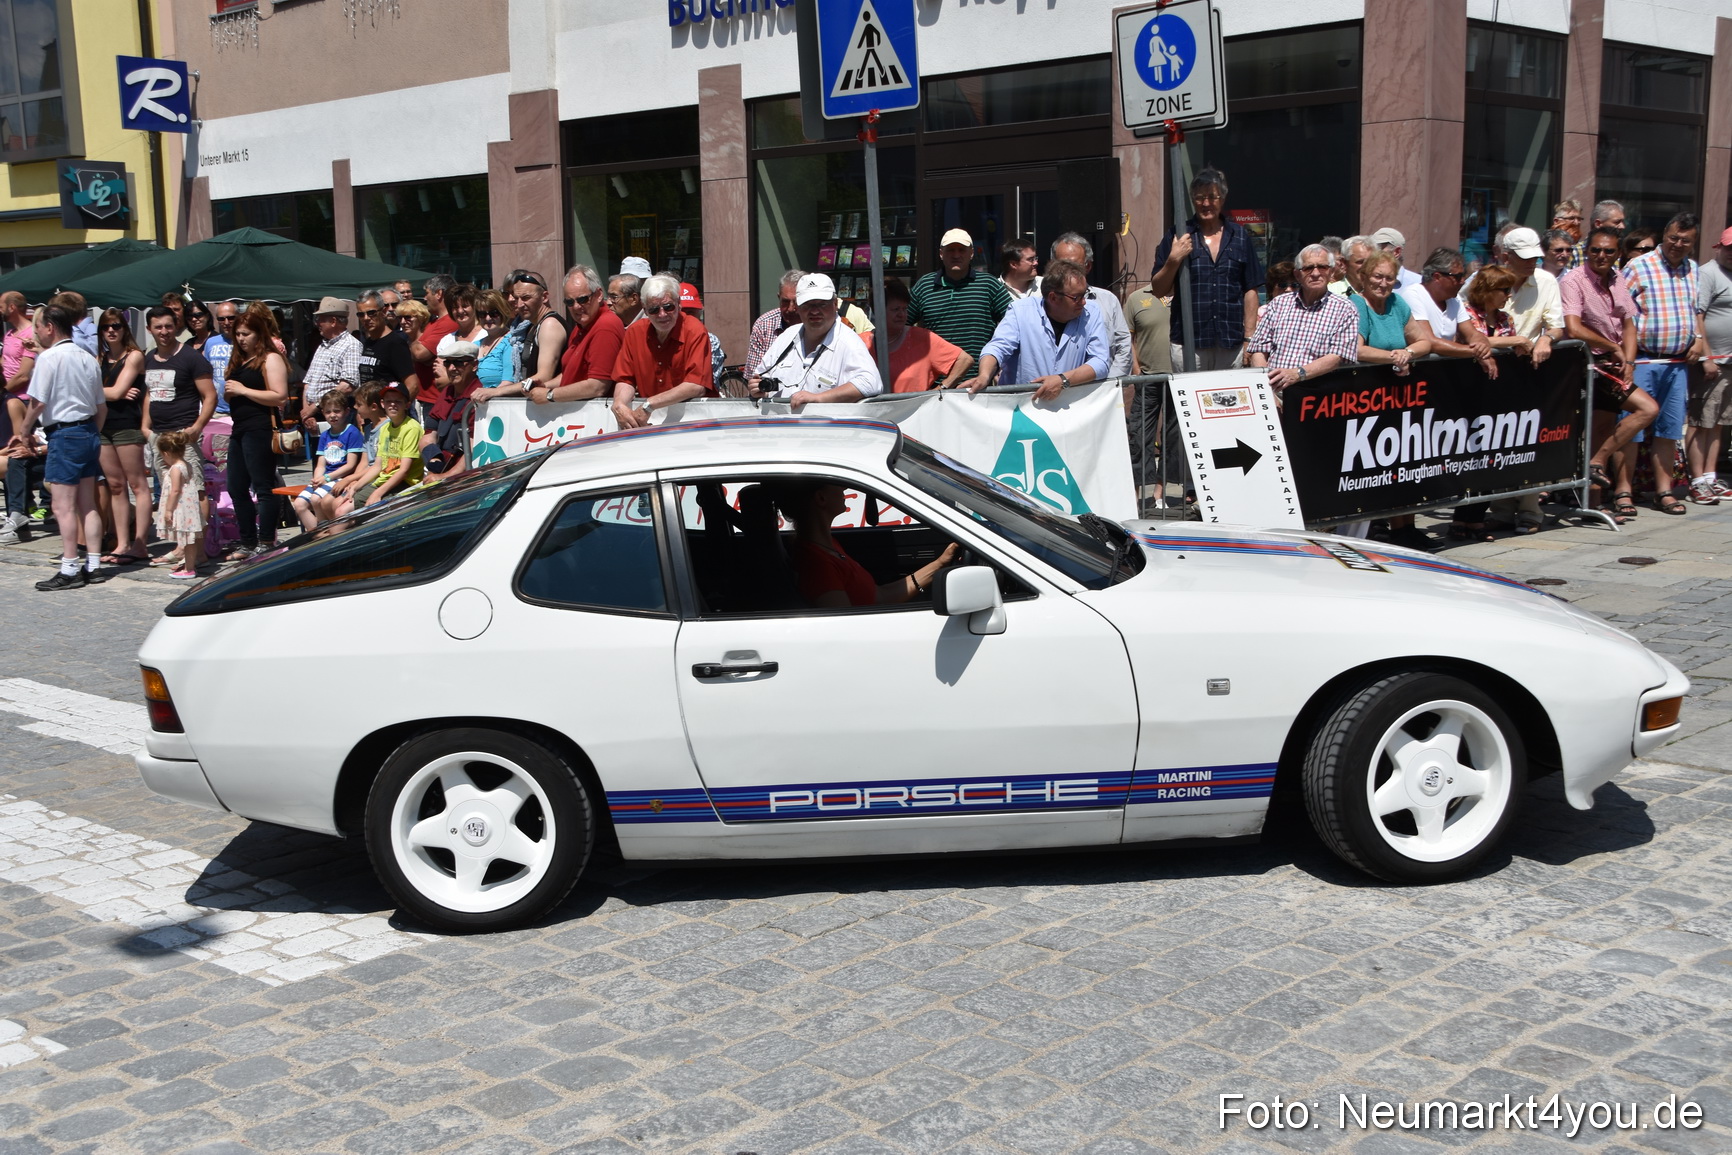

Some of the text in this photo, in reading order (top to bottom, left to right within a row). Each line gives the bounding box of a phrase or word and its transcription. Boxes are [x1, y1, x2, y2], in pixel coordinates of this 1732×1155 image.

[1145, 92, 1193, 117] ZONE
[200, 148, 250, 167] Unterer Markt 15
[88, 179, 112, 207] G2
[1300, 381, 1427, 422] FAHRSCHULE
[1177, 389, 1219, 523] RESIDENZPLATZ
[1256, 383, 1296, 515] RESIDENZPLATZ
[1341, 408, 1570, 473] Kohlmann GmbH
[1338, 451, 1535, 492] Neumarkt Burgthann Freystadt Pyrbaum
[1157, 770, 1212, 784] MARTINI
[1157, 786, 1212, 799] RACING
[769, 778, 1099, 813] PORSCHE
